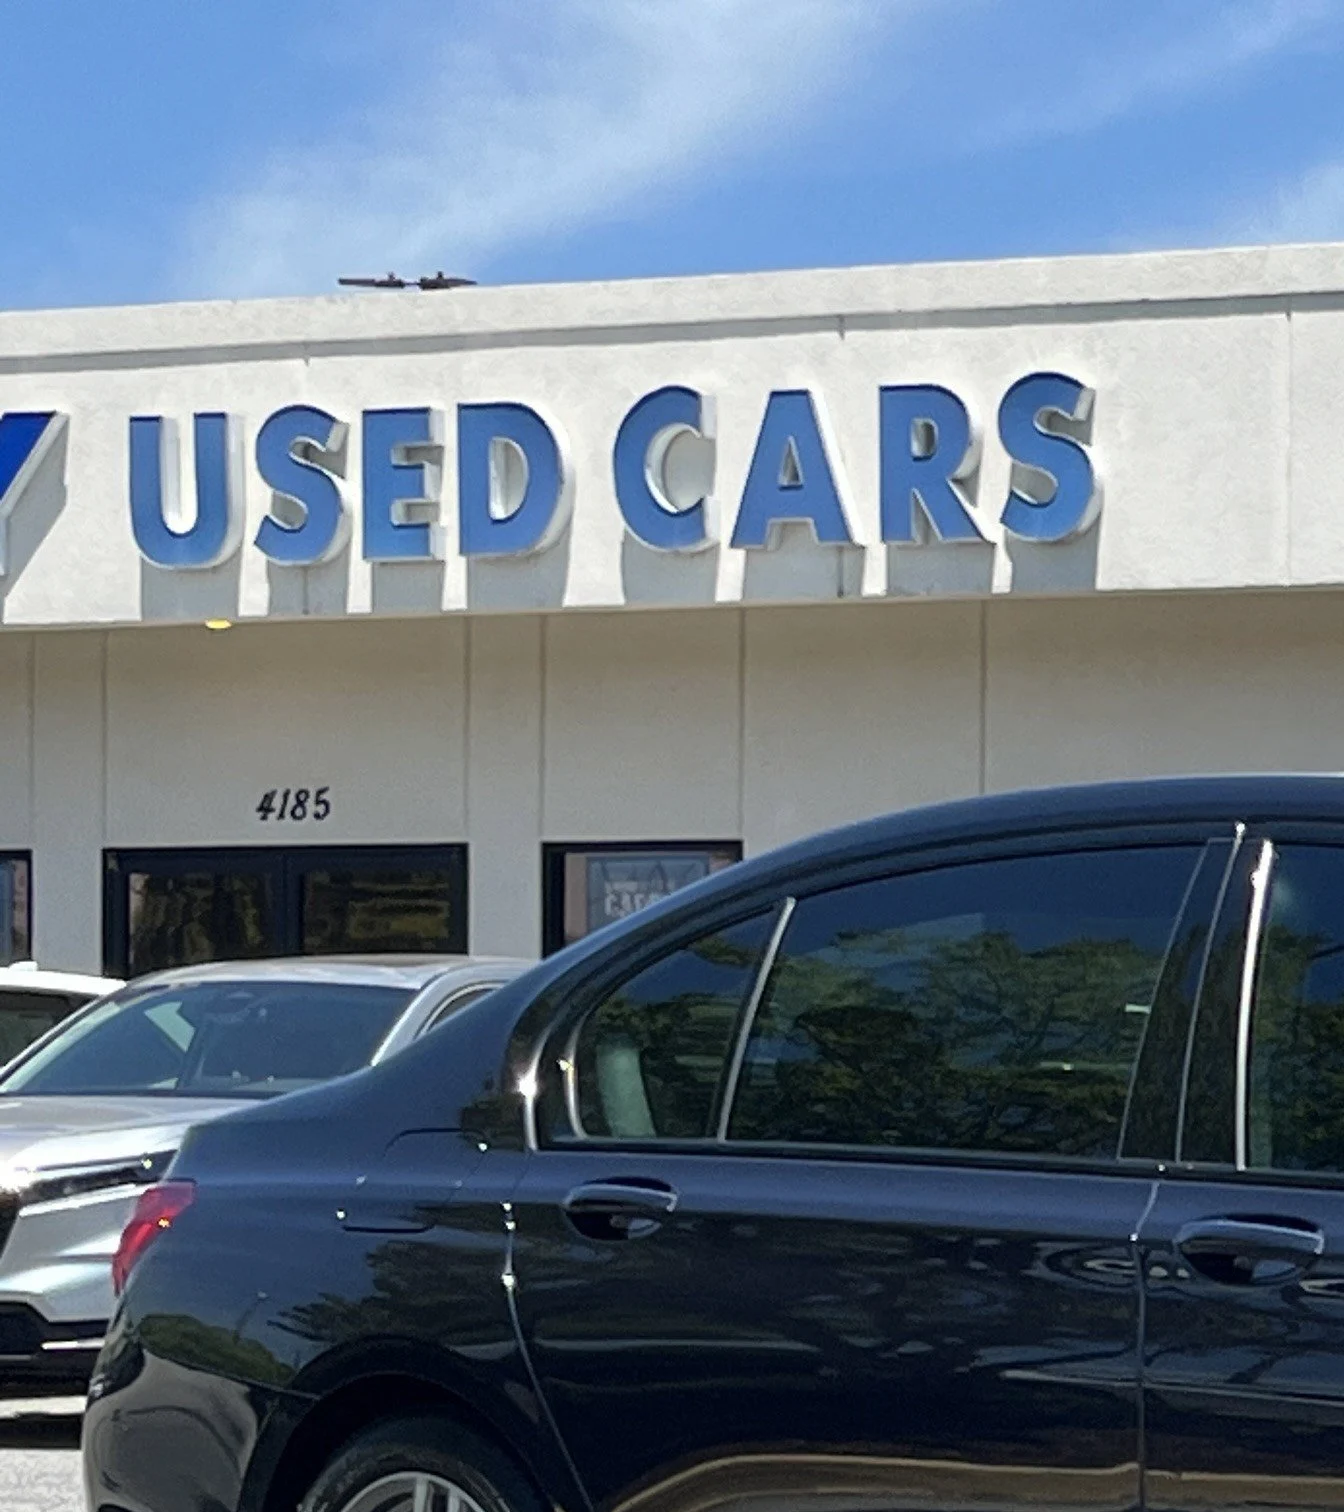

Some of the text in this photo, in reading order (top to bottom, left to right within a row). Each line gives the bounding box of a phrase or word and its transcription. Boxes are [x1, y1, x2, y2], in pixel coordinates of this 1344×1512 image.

[130, 402, 574, 569] USED
[613, 372, 1096, 552] CARS
[255, 786, 331, 822] 4185
